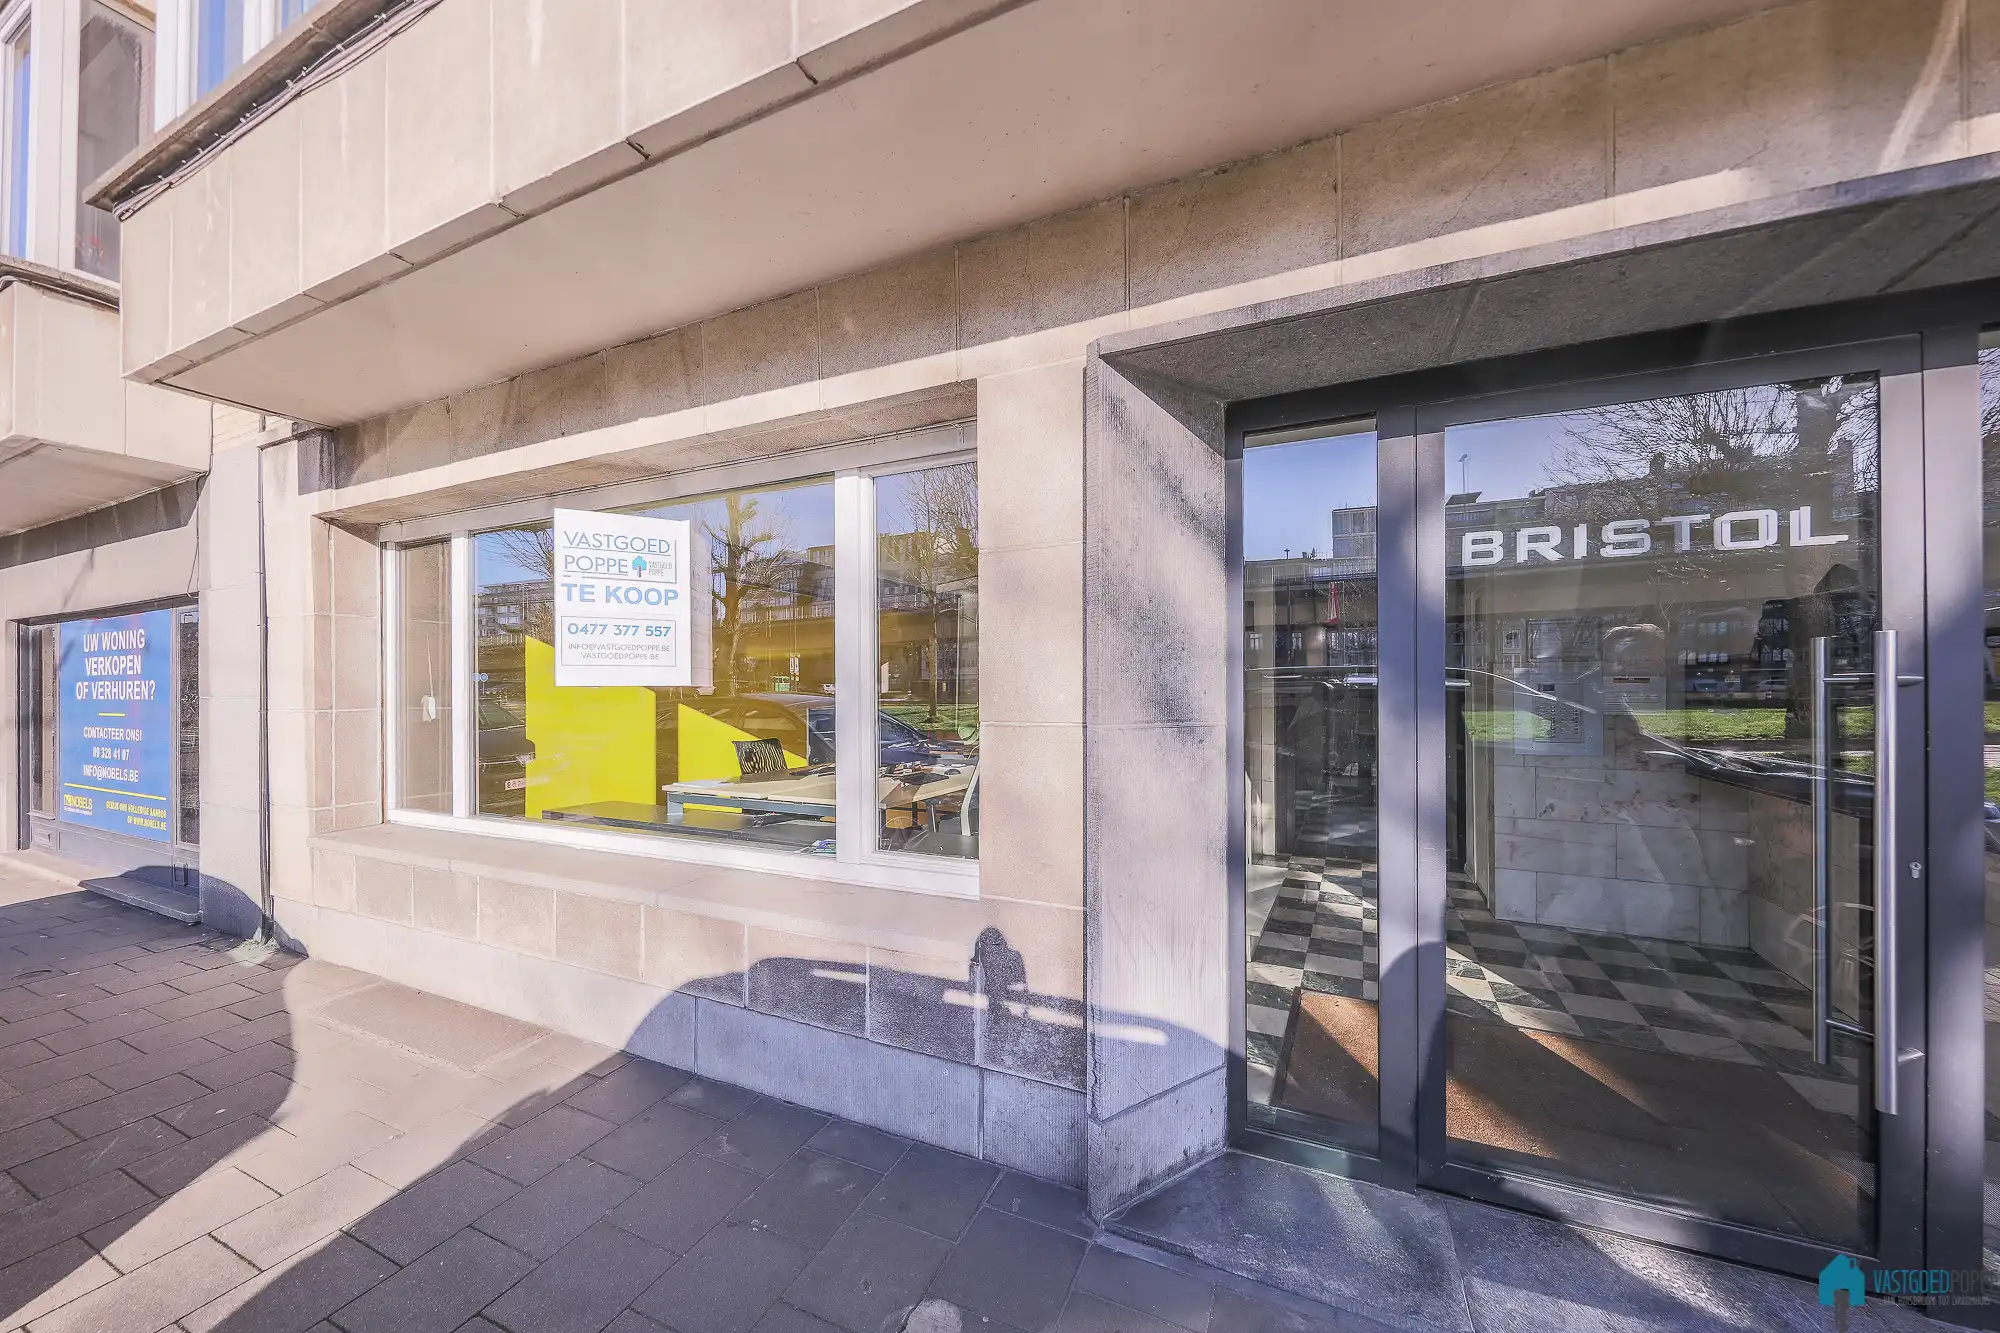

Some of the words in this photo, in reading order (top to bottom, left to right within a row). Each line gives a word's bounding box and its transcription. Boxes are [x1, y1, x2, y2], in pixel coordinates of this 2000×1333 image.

[563, 531, 670, 554] VASTGOED
[1461, 505, 1849, 567] BRISTOL
[564, 555, 628, 574] POPPE
[649, 561, 673, 570] VASTGOED
[561, 583, 596, 603] TE
[605, 585, 679, 606] KOOP
[567, 622, 608, 636] 0477
[613, 624, 640, 636] 377
[645, 625, 672, 637] 557
[83, 632, 100, 652] UW
[101, 628, 146, 651] WONING
[568, 642, 671, 652] INFO@VASTGOEDPOPPE.BE
[581, 652, 660, 660] VASTGOEDPOPPE.BE
[85, 655, 142, 677] VERKOPEN
[76, 683, 89, 700] OF
[90, 680, 156, 700] VERHUREN?
[83, 727, 124, 741] CONTACTEER
[125, 730, 142, 742] ONS!
[92, 746, 100, 758] 09
[113, 749, 121, 760] 41
[122, 749, 130, 761] 07
[83, 764, 139, 783] INFO@NOBELS.BE
[71, 795, 93, 810] NOBELS
